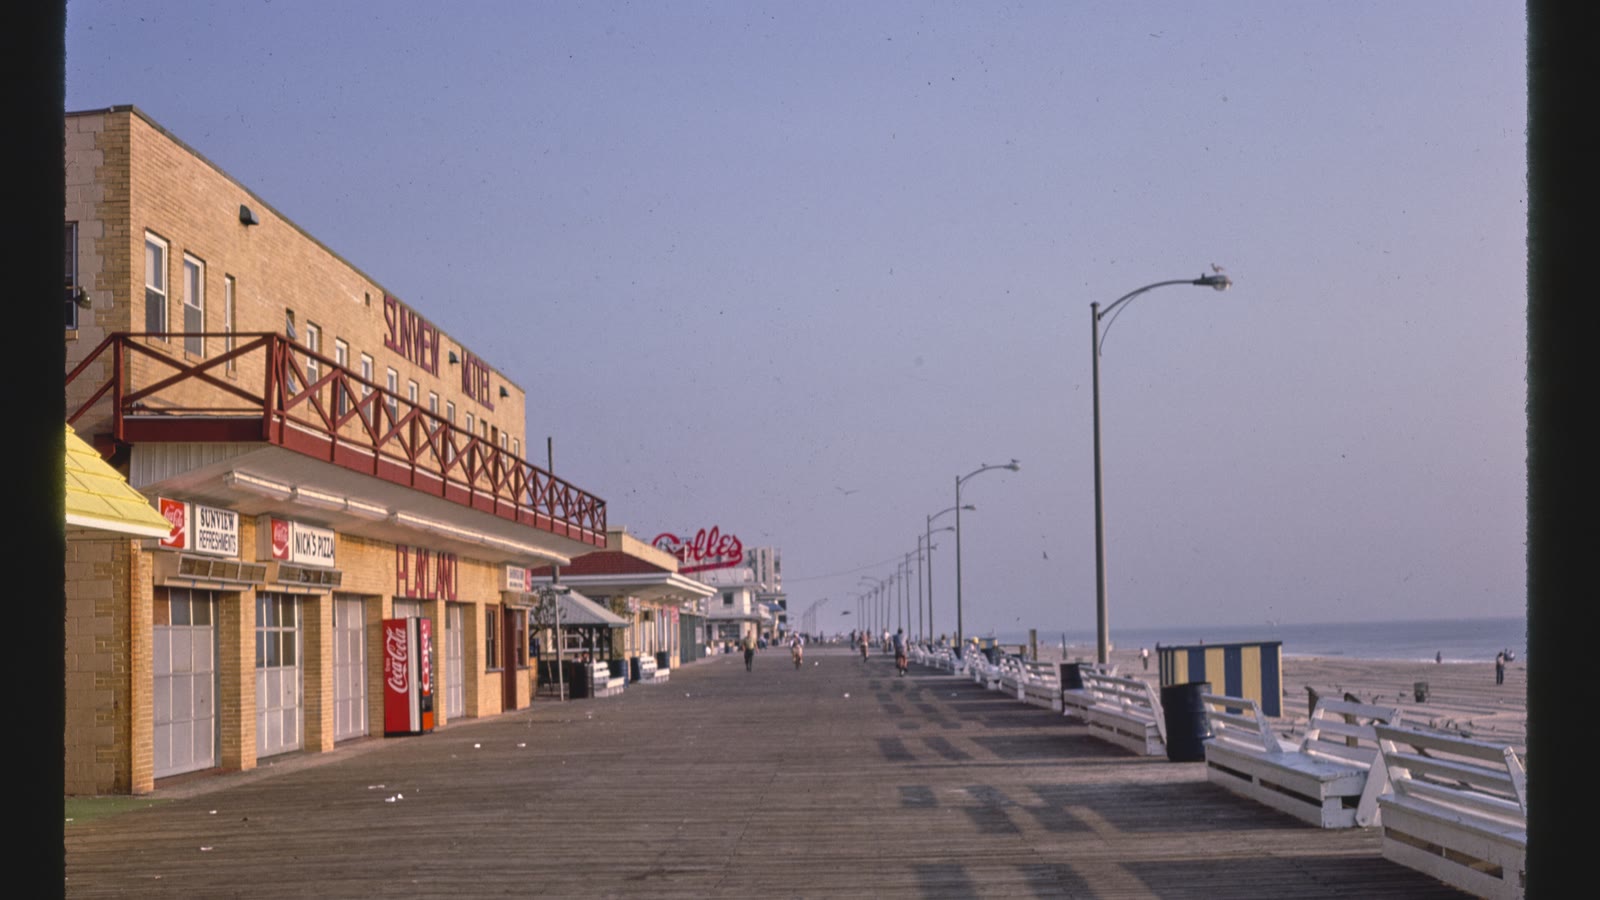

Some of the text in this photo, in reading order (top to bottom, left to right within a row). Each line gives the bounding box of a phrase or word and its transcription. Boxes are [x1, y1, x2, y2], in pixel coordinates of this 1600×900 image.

[384, 294, 495, 413] SUNVIEW MOTEL
[199, 529, 236, 553] REFRESHMENTS
[200, 507, 235, 532] SUNVIEW
[295, 530, 334, 559] NICK'S PIZZA
[396, 543, 458, 602] PLAYLAND
[386, 626, 408, 694] Coca-Cola
